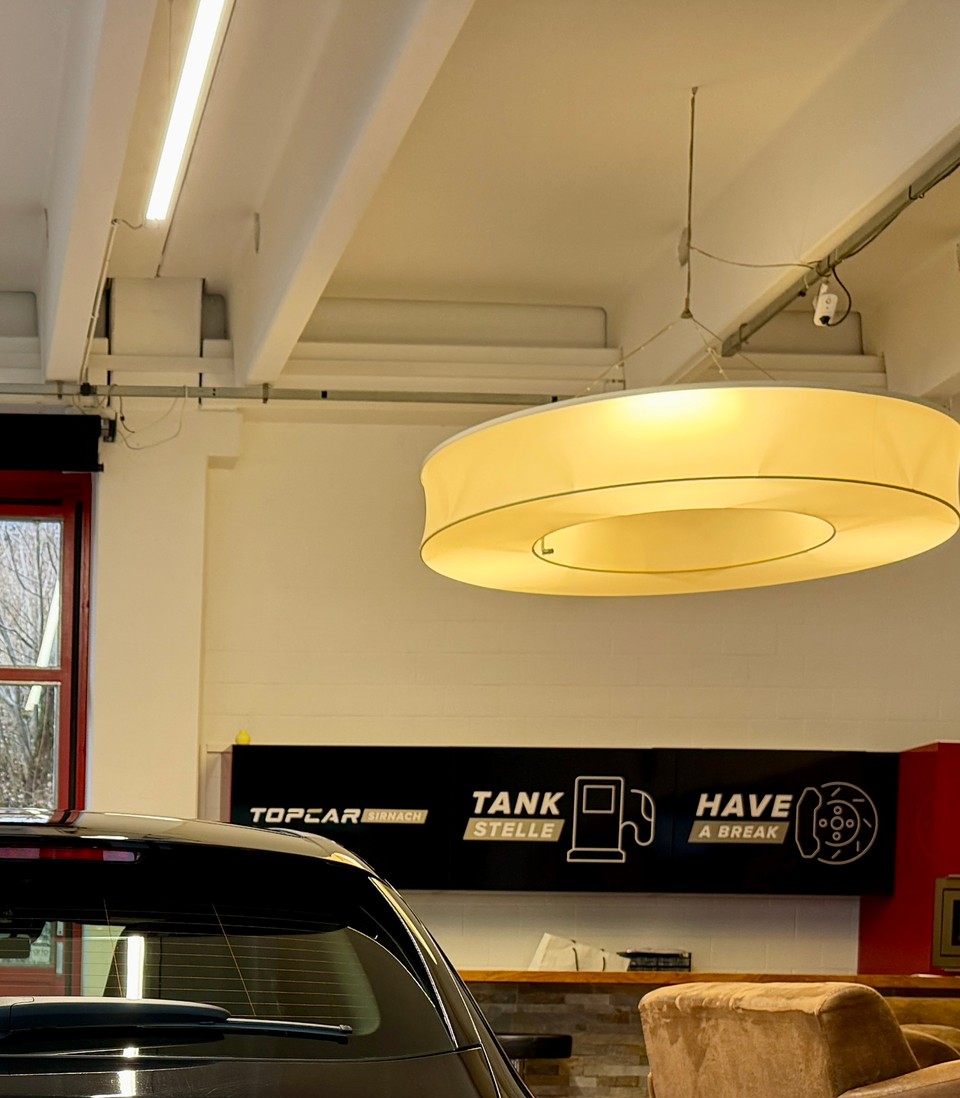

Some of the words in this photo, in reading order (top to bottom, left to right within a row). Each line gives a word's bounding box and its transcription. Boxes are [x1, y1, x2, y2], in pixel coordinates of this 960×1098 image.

[472, 791, 565, 815] TANK
[695, 793, 793, 818] HAVE
[249, 807, 361, 824] TOPCAR
[367, 810, 422, 821] SIRNACH
[473, 821, 555, 838] STELLE
[698, 825, 711, 838] A
[718, 825, 780, 839] BREAK
